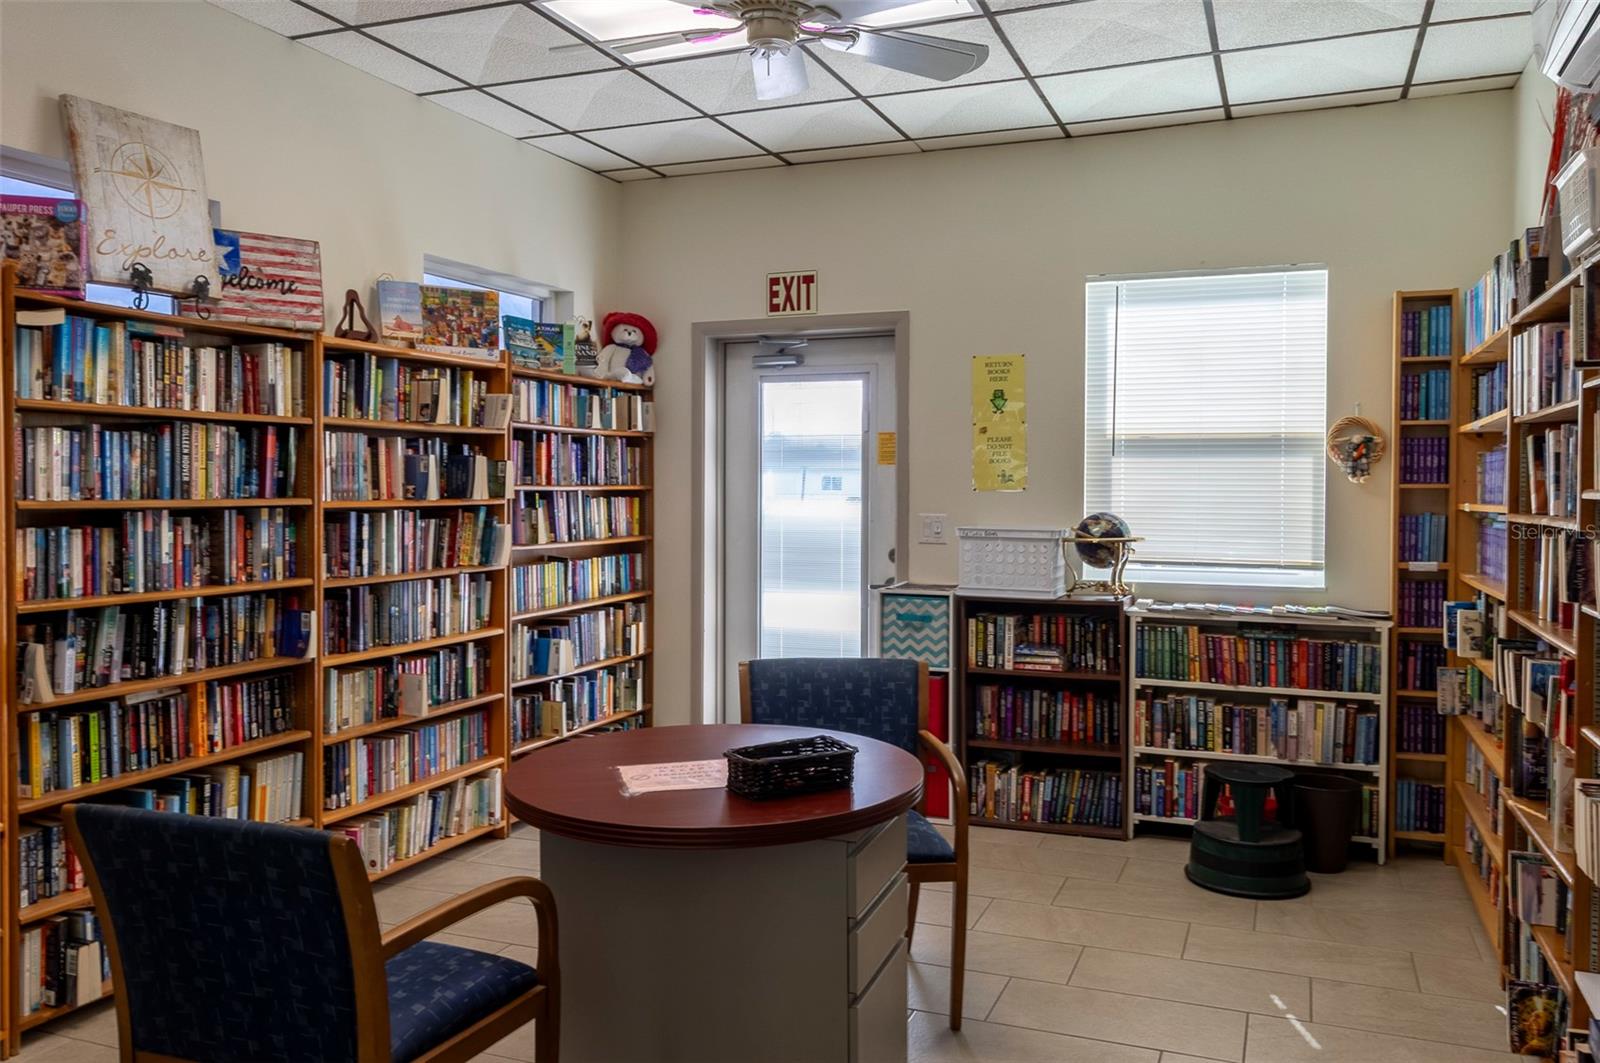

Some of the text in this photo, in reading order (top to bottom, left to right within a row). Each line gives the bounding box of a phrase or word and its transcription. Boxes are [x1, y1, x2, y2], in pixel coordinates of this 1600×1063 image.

[29, 205, 54, 216] PRESS
[96, 228, 211, 271] Explore
[768, 274, 815, 313] EXIT
[182, 424, 190, 482] COLLEEN HOOVER
